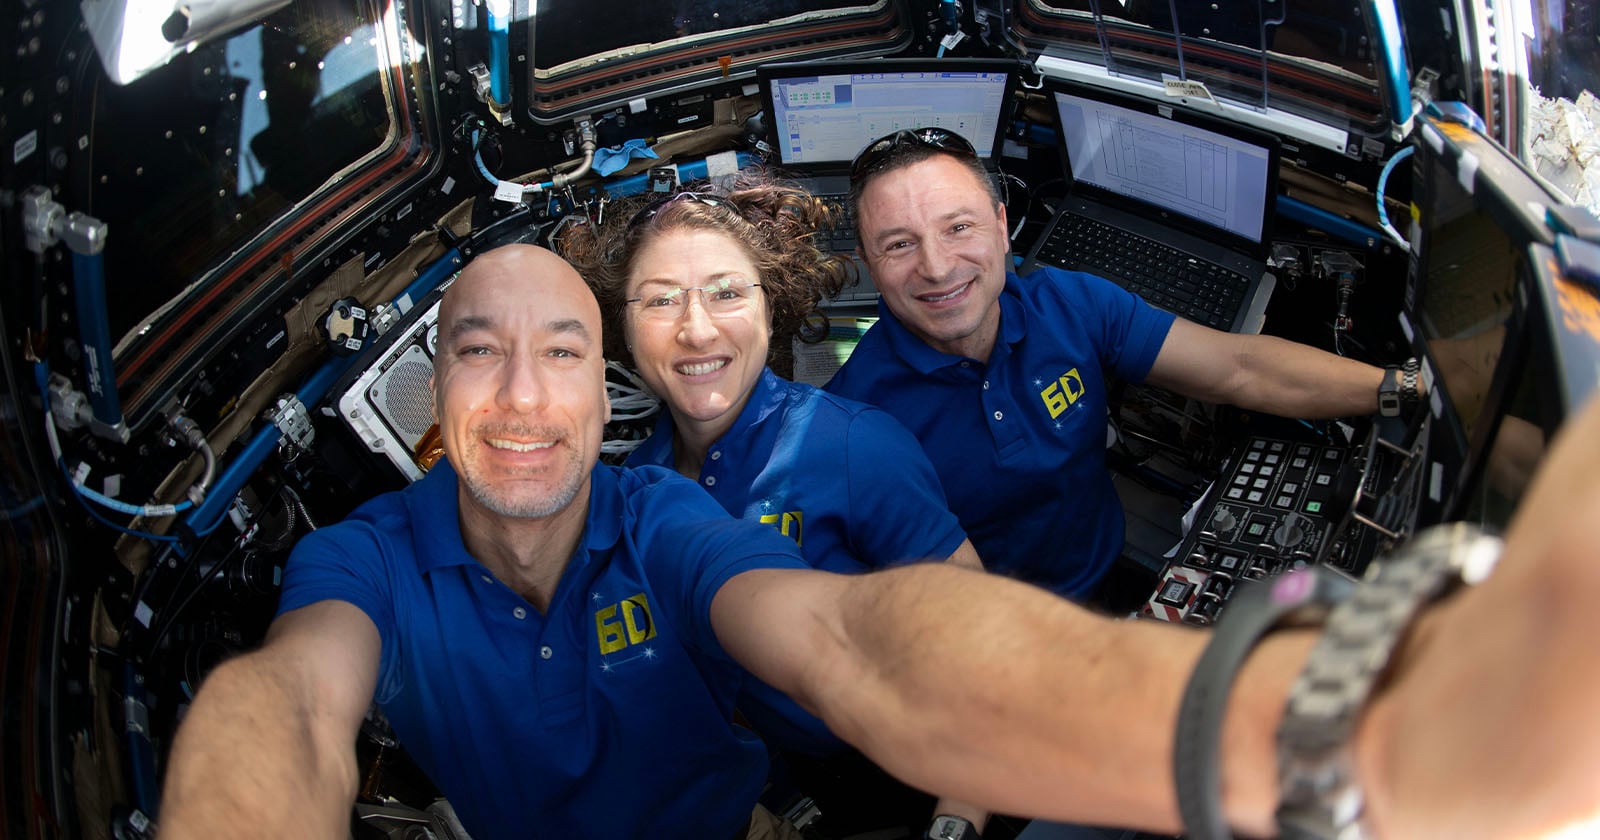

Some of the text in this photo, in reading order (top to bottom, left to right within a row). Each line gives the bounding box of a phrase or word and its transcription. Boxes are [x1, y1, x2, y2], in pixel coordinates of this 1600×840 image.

[383, 356, 397, 370] AUDIO
[1040, 367, 1085, 420] 60
[595, 592, 657, 656] 60
